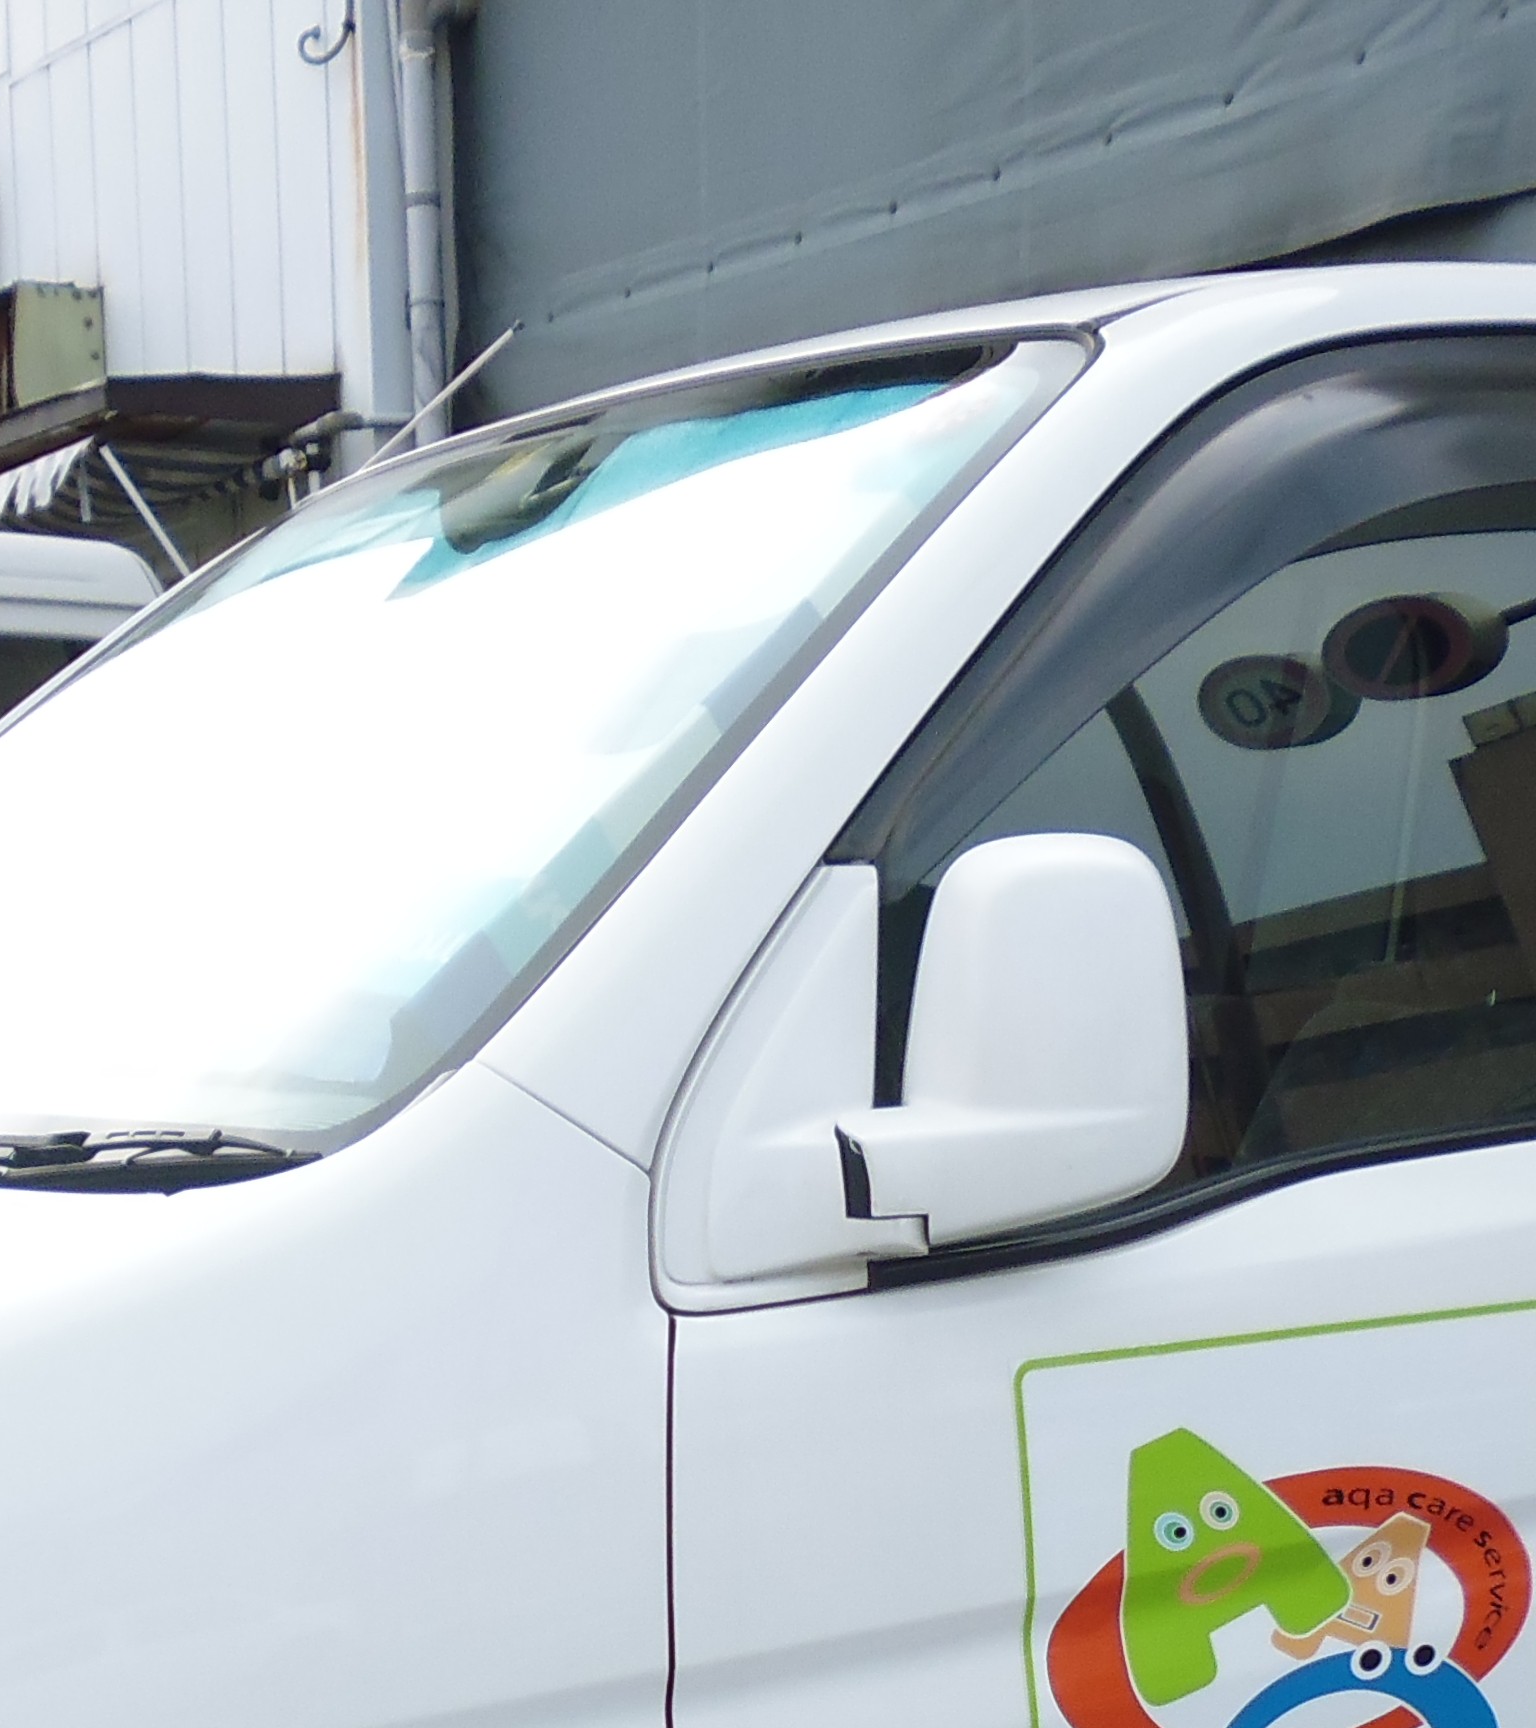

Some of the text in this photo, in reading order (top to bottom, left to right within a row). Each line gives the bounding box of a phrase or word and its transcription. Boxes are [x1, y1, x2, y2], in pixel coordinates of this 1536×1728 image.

[1321, 1486, 1510, 1651] aqa care service
